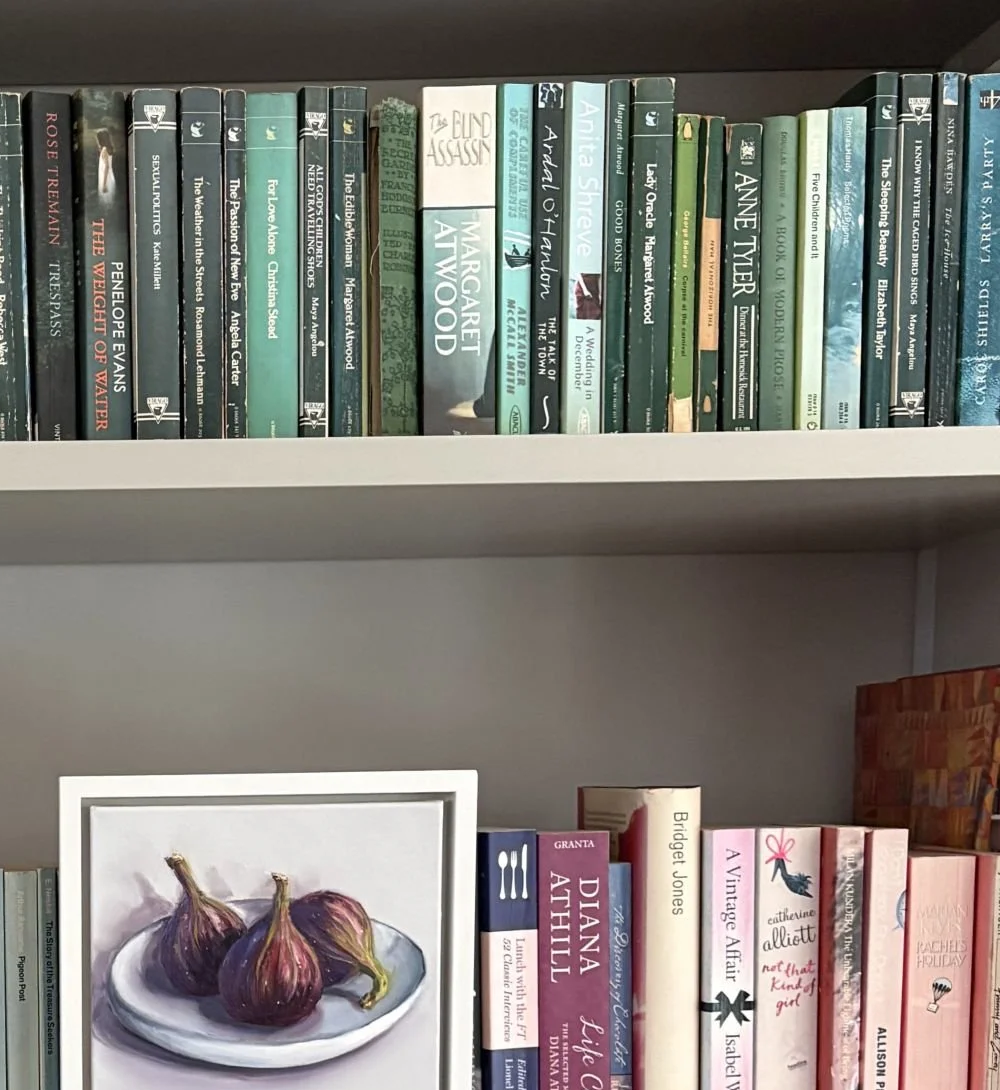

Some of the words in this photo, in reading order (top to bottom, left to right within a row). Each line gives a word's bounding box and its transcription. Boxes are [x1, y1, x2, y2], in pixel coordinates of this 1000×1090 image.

[811, 173, 820, 191] Five
[881, 158, 892, 178] The
[614, 200, 624, 233] GOOD
[733, 171, 758, 230] ANNE
[810, 194, 820, 231] Children
[879, 180, 892, 227] Sleeping
[613, 238, 623, 272] BONES
[810, 234, 819, 249] and
[876, 229, 890, 267] Beauty
[434, 220, 457, 355] ATWOOD
[460, 220, 481, 355] MARGARET
[732, 236, 756, 297] TYLER
[111, 261, 125, 338] PENELOPE
[310, 297, 320, 319] Maya
[875, 279, 888, 328] Elizabeth
[195, 307, 205, 356] Rosamond
[228, 311, 241, 348] Angela
[310, 322, 321, 357] Angelou
[875, 330, 886, 359] Taylor
[113, 343, 126, 393] EVANS
[196, 358, 205, 405] Lehmann
[230, 351, 241, 386] Carter
[574, 335, 584, 391] December
[554, 841, 595, 849] GRANTA
[669, 812, 688, 864] Bridget
[725, 849, 739, 861] A
[671, 871, 687, 915] Jones
[721, 866, 741, 931] Vintage
[550, 871, 571, 983] ATHILL
[579, 878, 600, 974] DIANA
[16, 956, 26, 981] Pigeon
[725, 936, 740, 982] Affair
[18, 984, 27, 1001] Post
[504, 1059, 514, 1089] Lionel
[725, 1034, 741, 1079] Isabel
[876, 1027, 887, 1077] ALLISON
